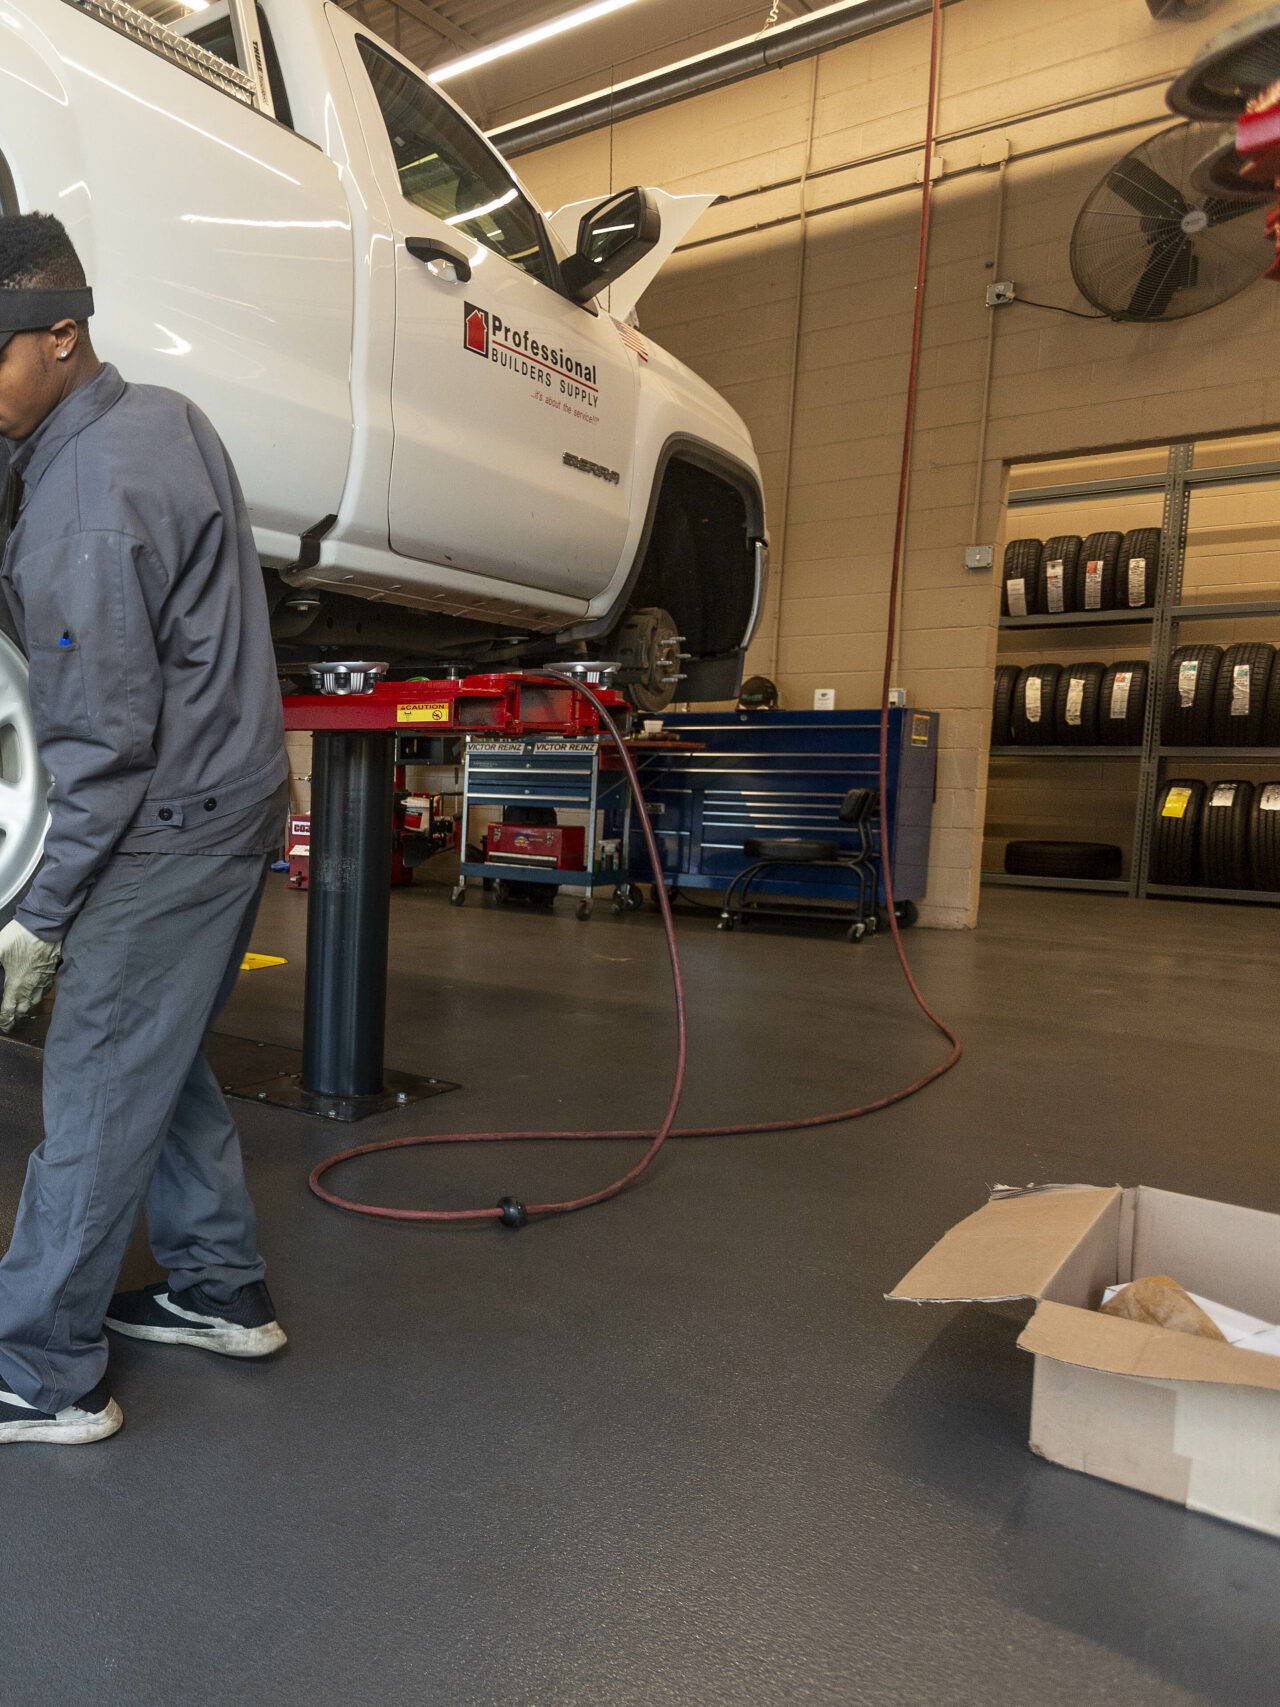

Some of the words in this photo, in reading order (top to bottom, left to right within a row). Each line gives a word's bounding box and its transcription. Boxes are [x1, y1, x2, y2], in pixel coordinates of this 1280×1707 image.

[252, 41, 263, 75] THULE
[491, 314, 597, 386] Professional
[491, 349, 552, 388] BUILDERS
[559, 379, 599, 408] SUPPLY
[545, 396, 561, 410] about
[563, 403, 571, 414] the
[468, 743, 496, 751] VICTOR
[497, 743, 522, 751] REINZ
[536, 743, 567, 751] VICTOR
[568, 744, 595, 752] REINZ
